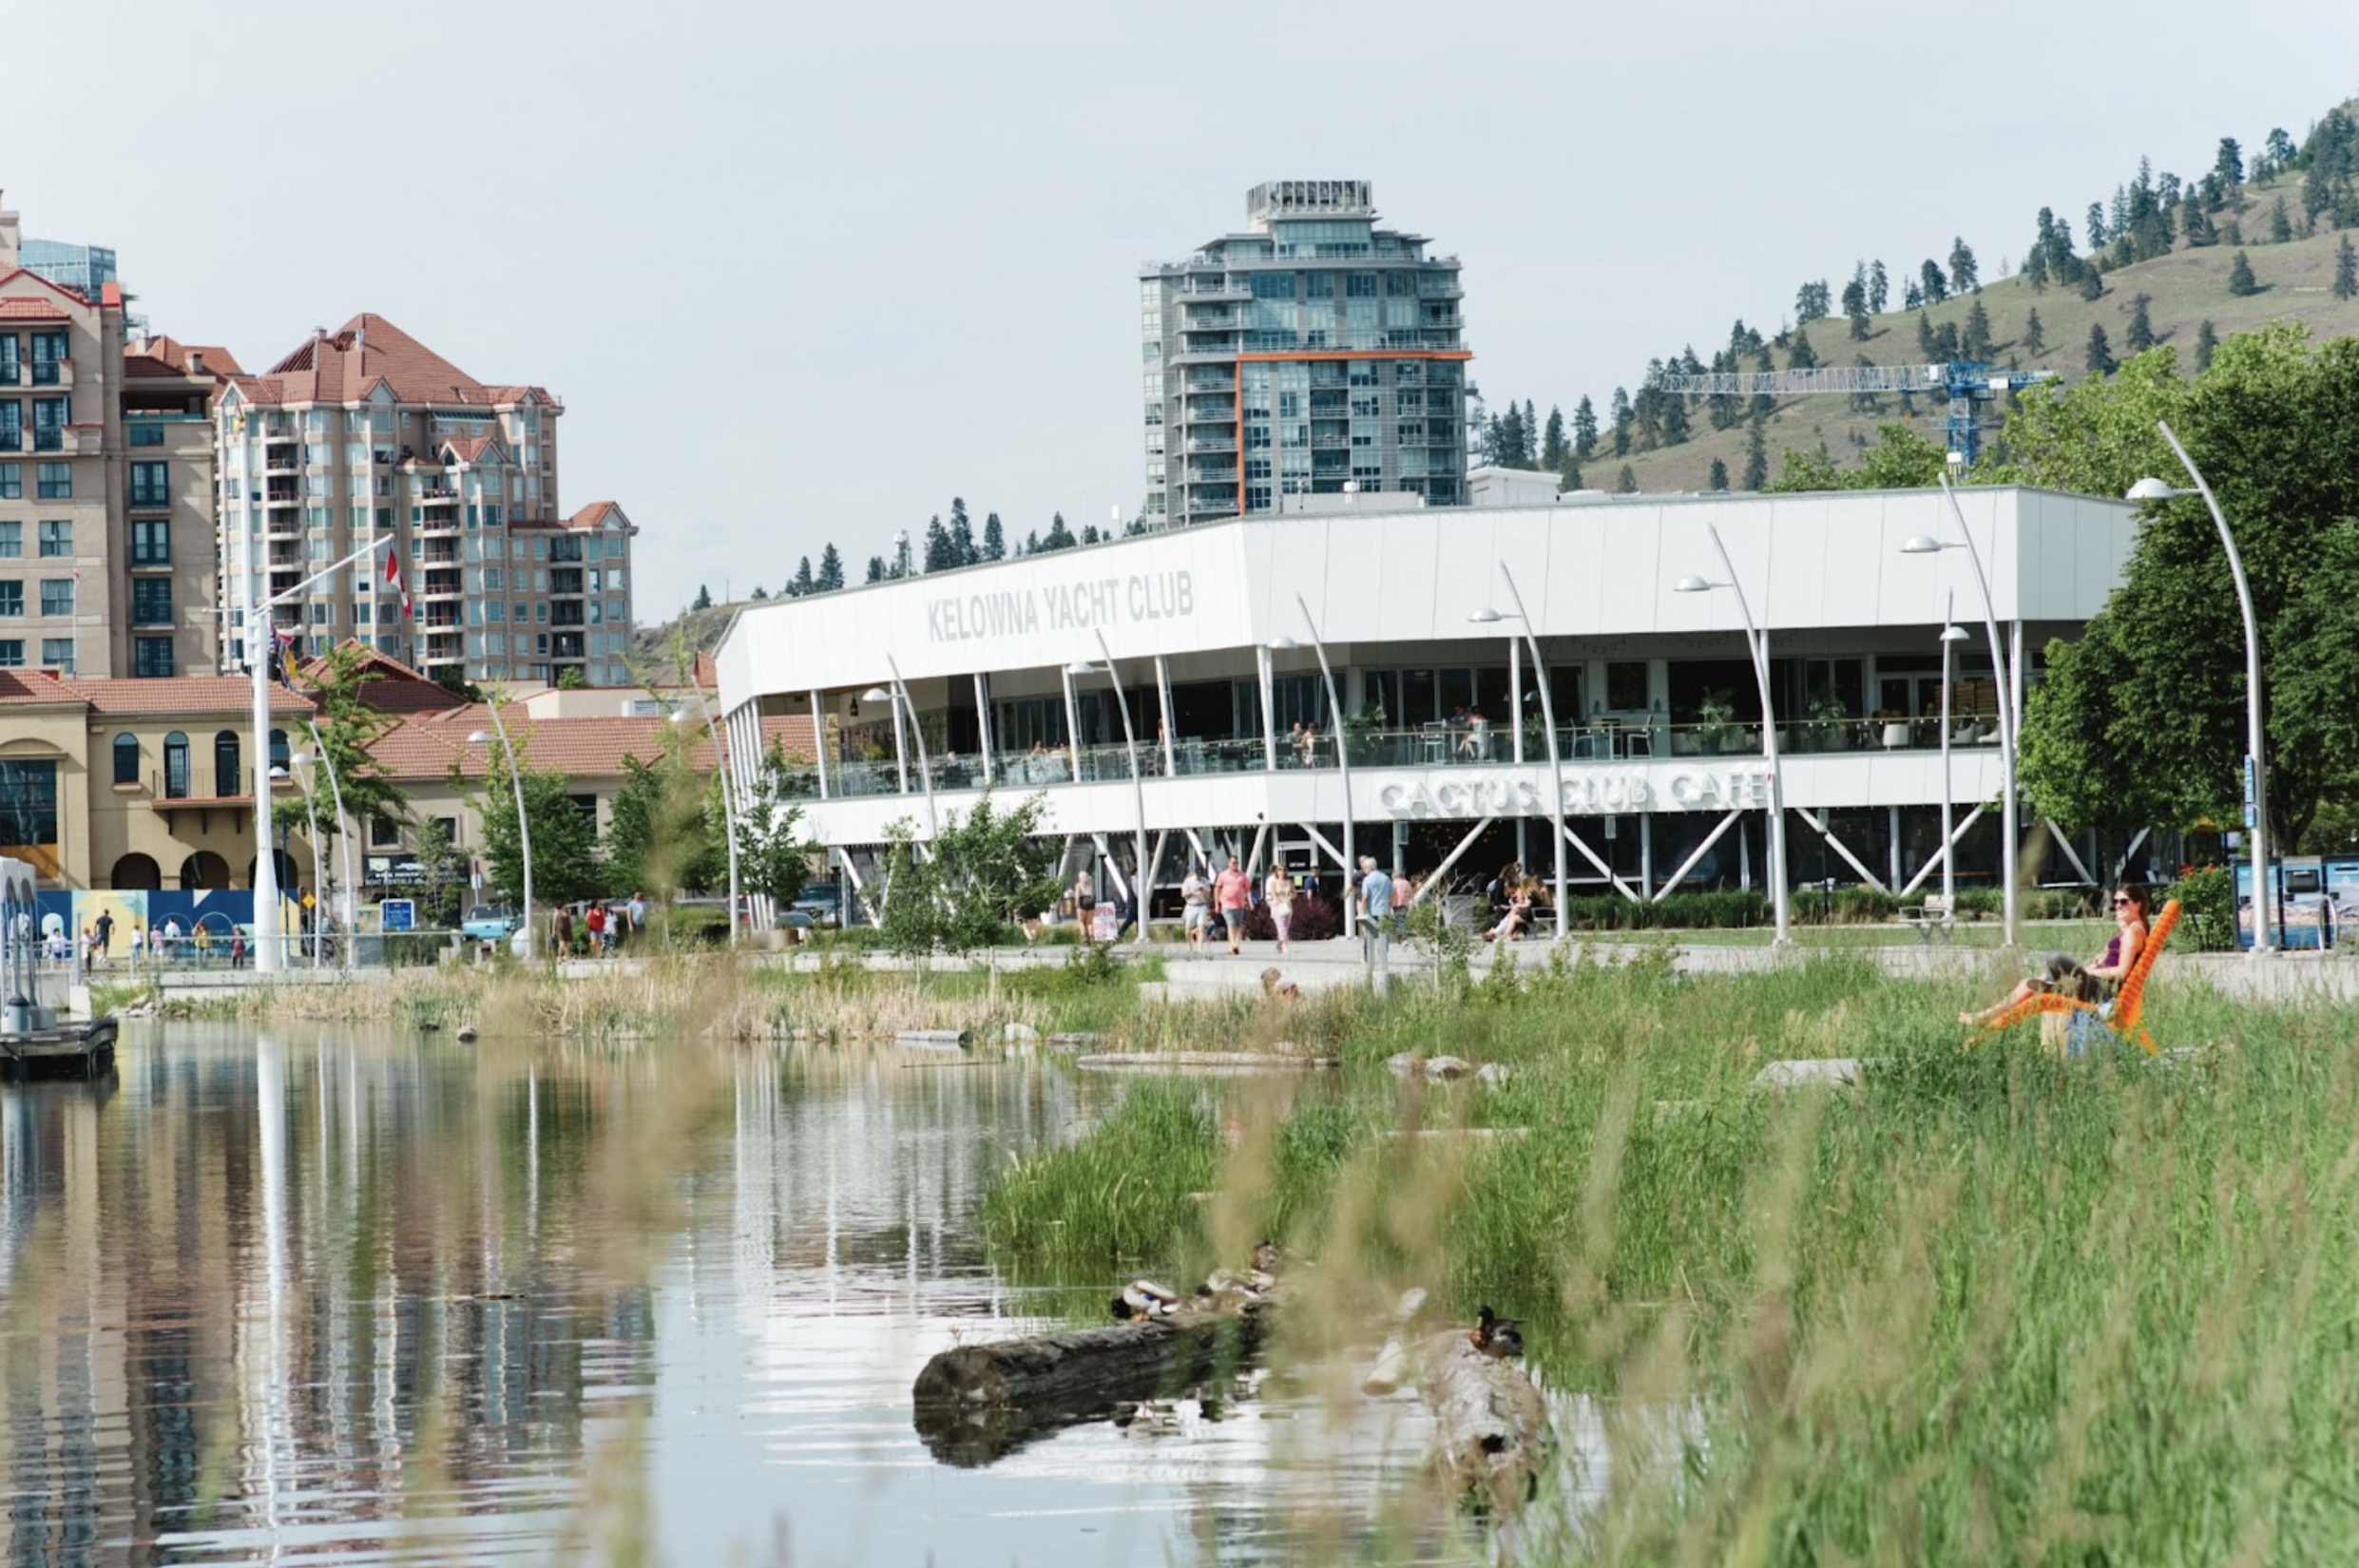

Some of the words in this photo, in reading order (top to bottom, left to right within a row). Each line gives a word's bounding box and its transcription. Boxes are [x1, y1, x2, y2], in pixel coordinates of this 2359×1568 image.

[928, 588, 1039, 642] KELOWNA
[1044, 578, 1119, 630] YACHT
[1128, 569, 1194, 621] CLUB
[1381, 777, 1536, 810] CACTUS
[1560, 774, 1648, 807] CLUB
[1672, 772, 1766, 805] CAFE
